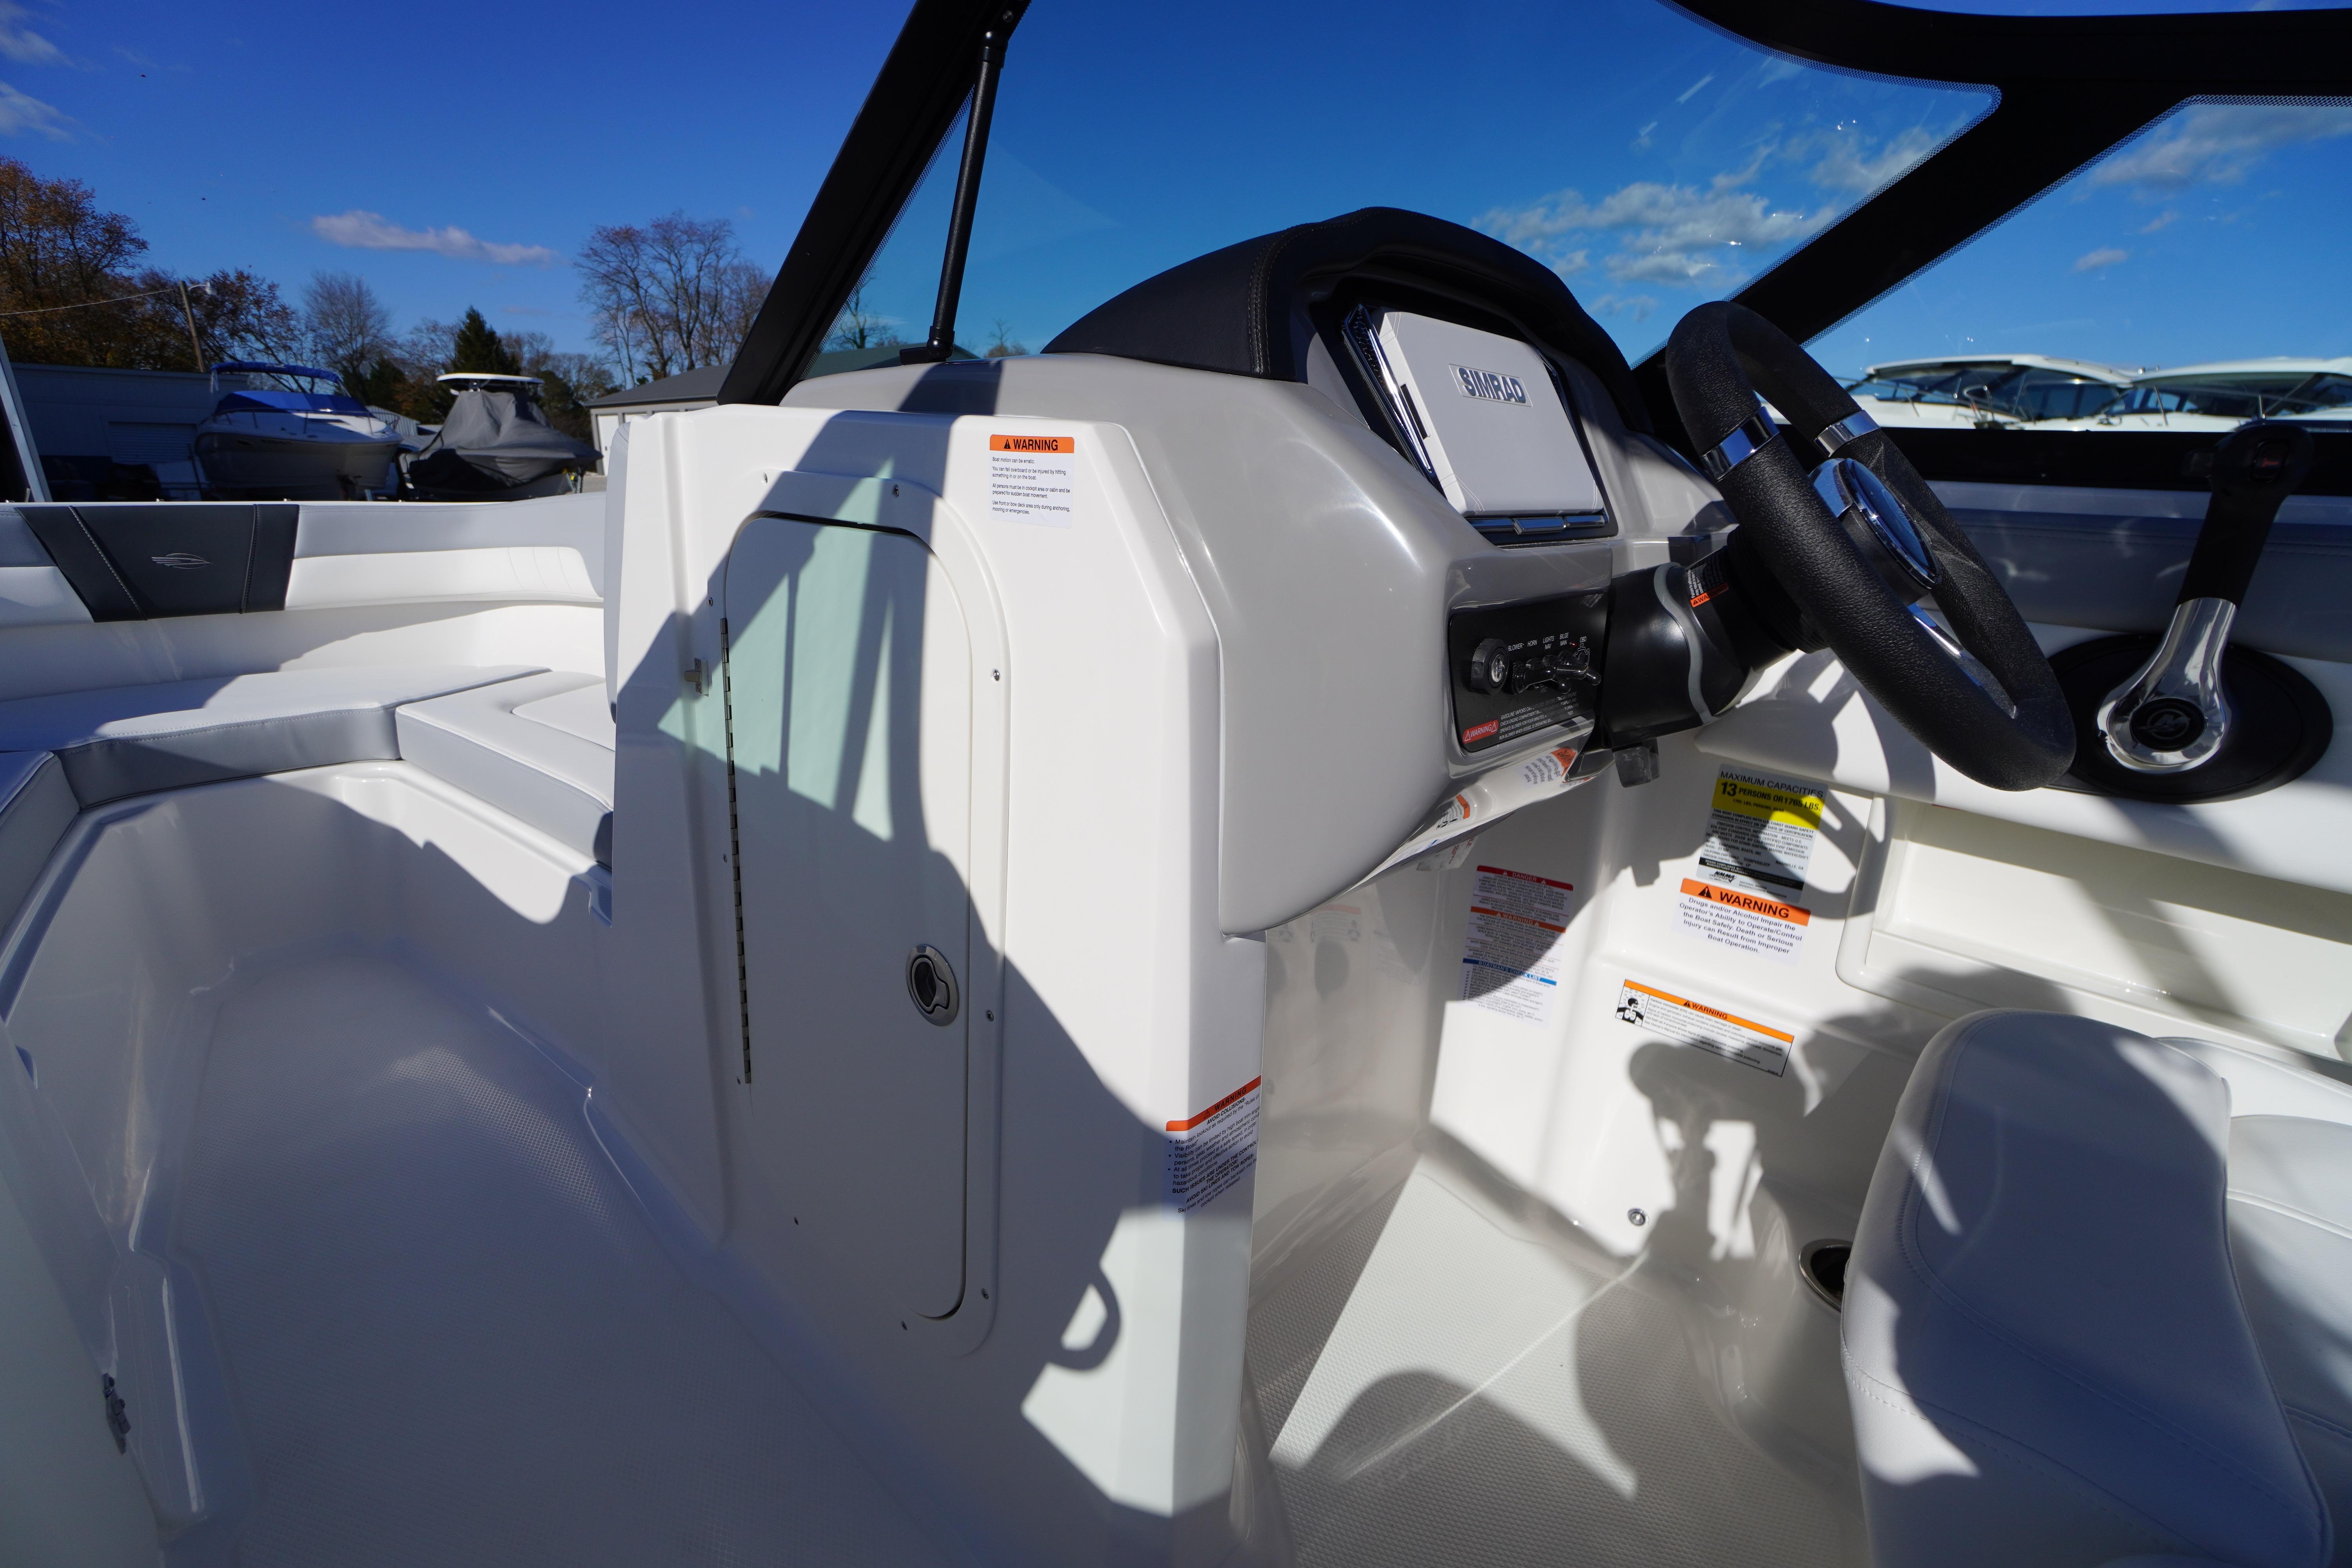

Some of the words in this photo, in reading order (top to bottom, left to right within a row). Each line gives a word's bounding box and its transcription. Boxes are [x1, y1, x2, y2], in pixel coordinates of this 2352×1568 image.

[1459, 367, 1526, 403] SIMRAD
[1013, 439, 1058, 450] WARNING
[1501, 711, 1515, 720] GASOLINE
[1519, 711, 1536, 720] COMPARTMENT
[1470, 725, 1492, 737] WARNING
[1719, 781, 1738, 797] 13
[1738, 787, 1771, 800] PERSONS
[1773, 795, 1783, 803] OR
[1784, 797, 1803, 807] 1765
[1804, 801, 1820, 811] LBS.
[1720, 771, 1765, 786] MAXIMUM
[1767, 780, 1823, 798] CAPACITIES
[1513, 872, 1537, 882] DANGER
[1689, 897, 1708, 907] Drugs
[1710, 904, 1731, 913] and/or
[1733, 909, 1759, 921] Alcohol
[1760, 917, 1782, 927] Impair
[1719, 891, 1790, 918] WARNING
[1503, 913, 1533, 924] WARNING
[1679, 902, 1713, 916] Operator's
[1715, 913, 1736, 924] Ability
[1746, 921, 1802, 941] Operate/Control
[1695, 915, 1711, 923] Boat
[1712, 919, 1733, 930] Safely.
[1736, 926, 1756, 936] Death
[1767, 935, 1793, 946] Serious
[1683, 919, 1701, 929] Injury
[1717, 928, 1739, 939] Result
[1740, 935, 1756, 944] from
[1758, 940, 1789, 953] Improper
[1708, 933, 1723, 942] Boat
[1725, 938, 1759, 953] Operation.
[1479, 961, 1509, 973] BOATMAN'S
[1510, 969, 1528, 977] CHECK
[1692, 1002, 1728, 1020] WARNING
[1215, 1086, 1246, 1111] WARNING
[1175, 1135, 1196, 1144] Maintain
[1197, 1125, 1210, 1137] lookout
[1217, 1111, 1232, 1124] required
[1207, 1113, 1220, 1124] AVOID
[1189, 1160, 1198, 1169] times
[1200, 1148, 1215, 1163] proceed
[1248, 1121, 1256, 1130] order
[1209, 1131, 1221, 1143] limited
[1190, 1175, 1205, 1189] ISSUES
[1216, 1158, 1229, 1172] UNDER
[1240, 1139, 1256, 1155] CONTROL
[1186, 1191, 1200, 1203] AVOID
[1209, 1176, 1220, 1188] LINES
